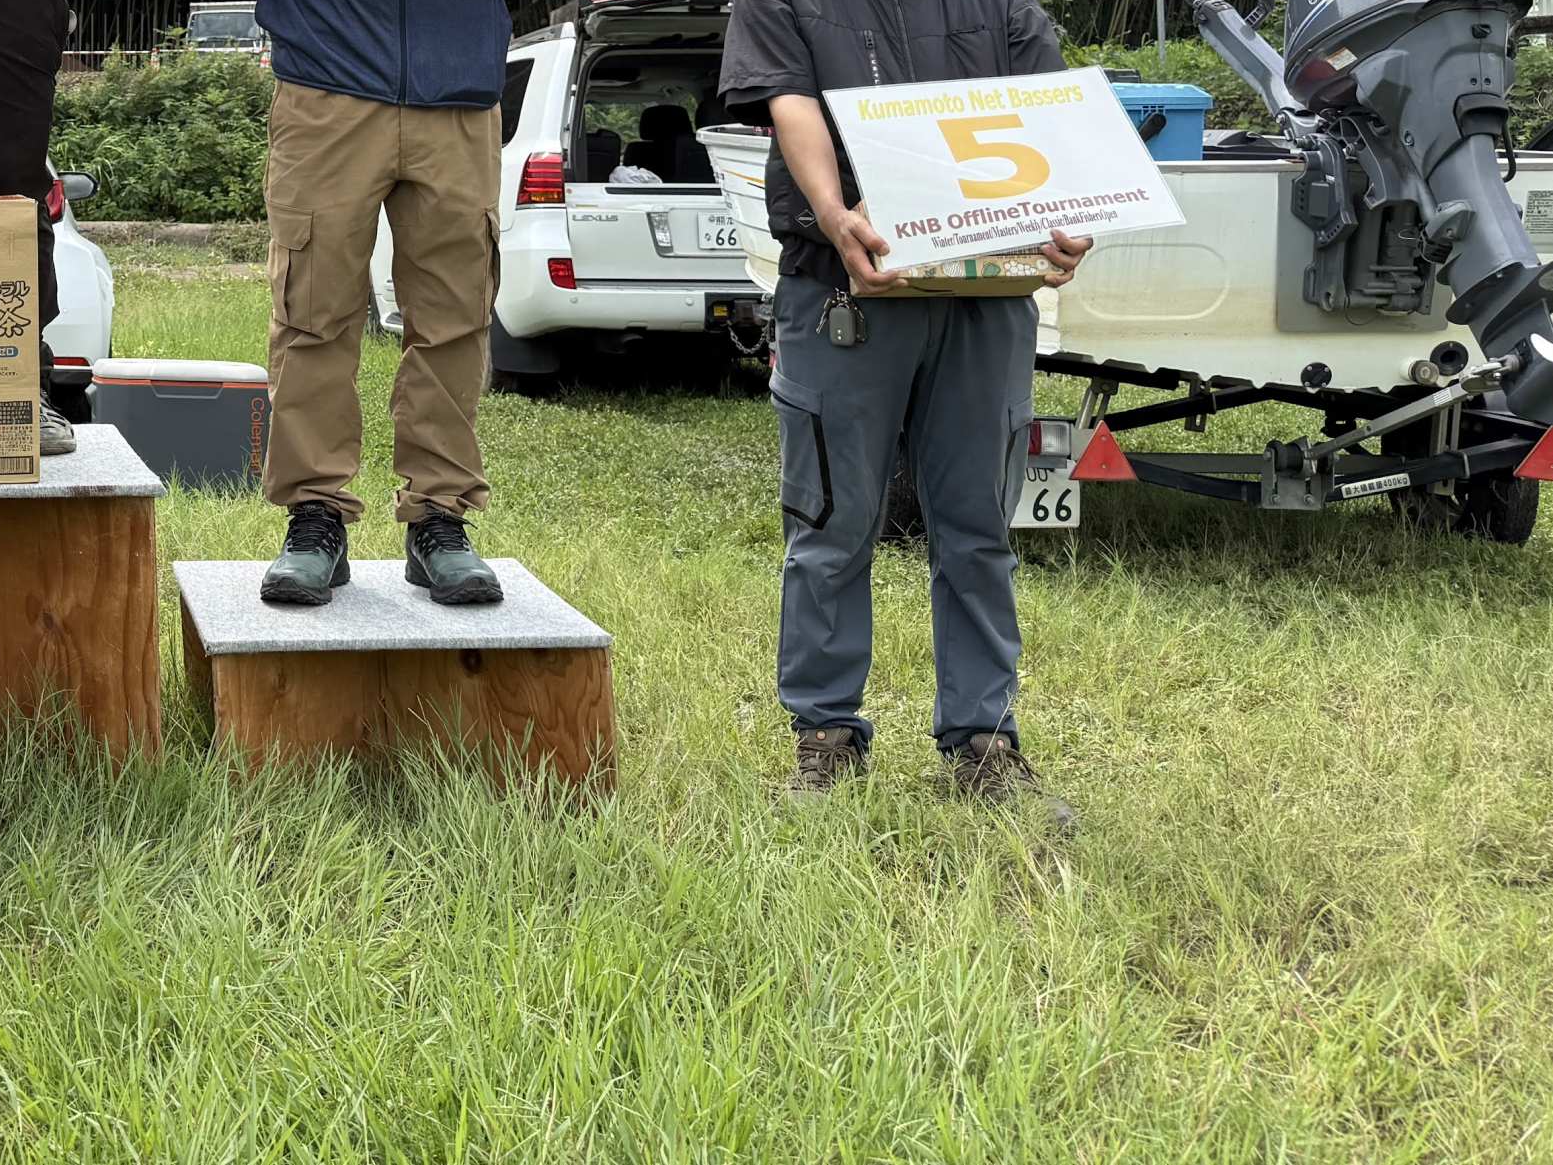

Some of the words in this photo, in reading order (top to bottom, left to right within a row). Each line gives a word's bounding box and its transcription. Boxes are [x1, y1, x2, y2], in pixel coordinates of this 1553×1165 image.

[857, 94, 966, 121] Kumamoto
[968, 88, 1004, 112] Net
[1010, 83, 1085, 109] Bassers
[936, 113, 1051, 200] 5
[895, 217, 942, 240] KNB
[947, 188, 1150, 231] OfflineTournament
[1033, 488, 1071, 522] 66
